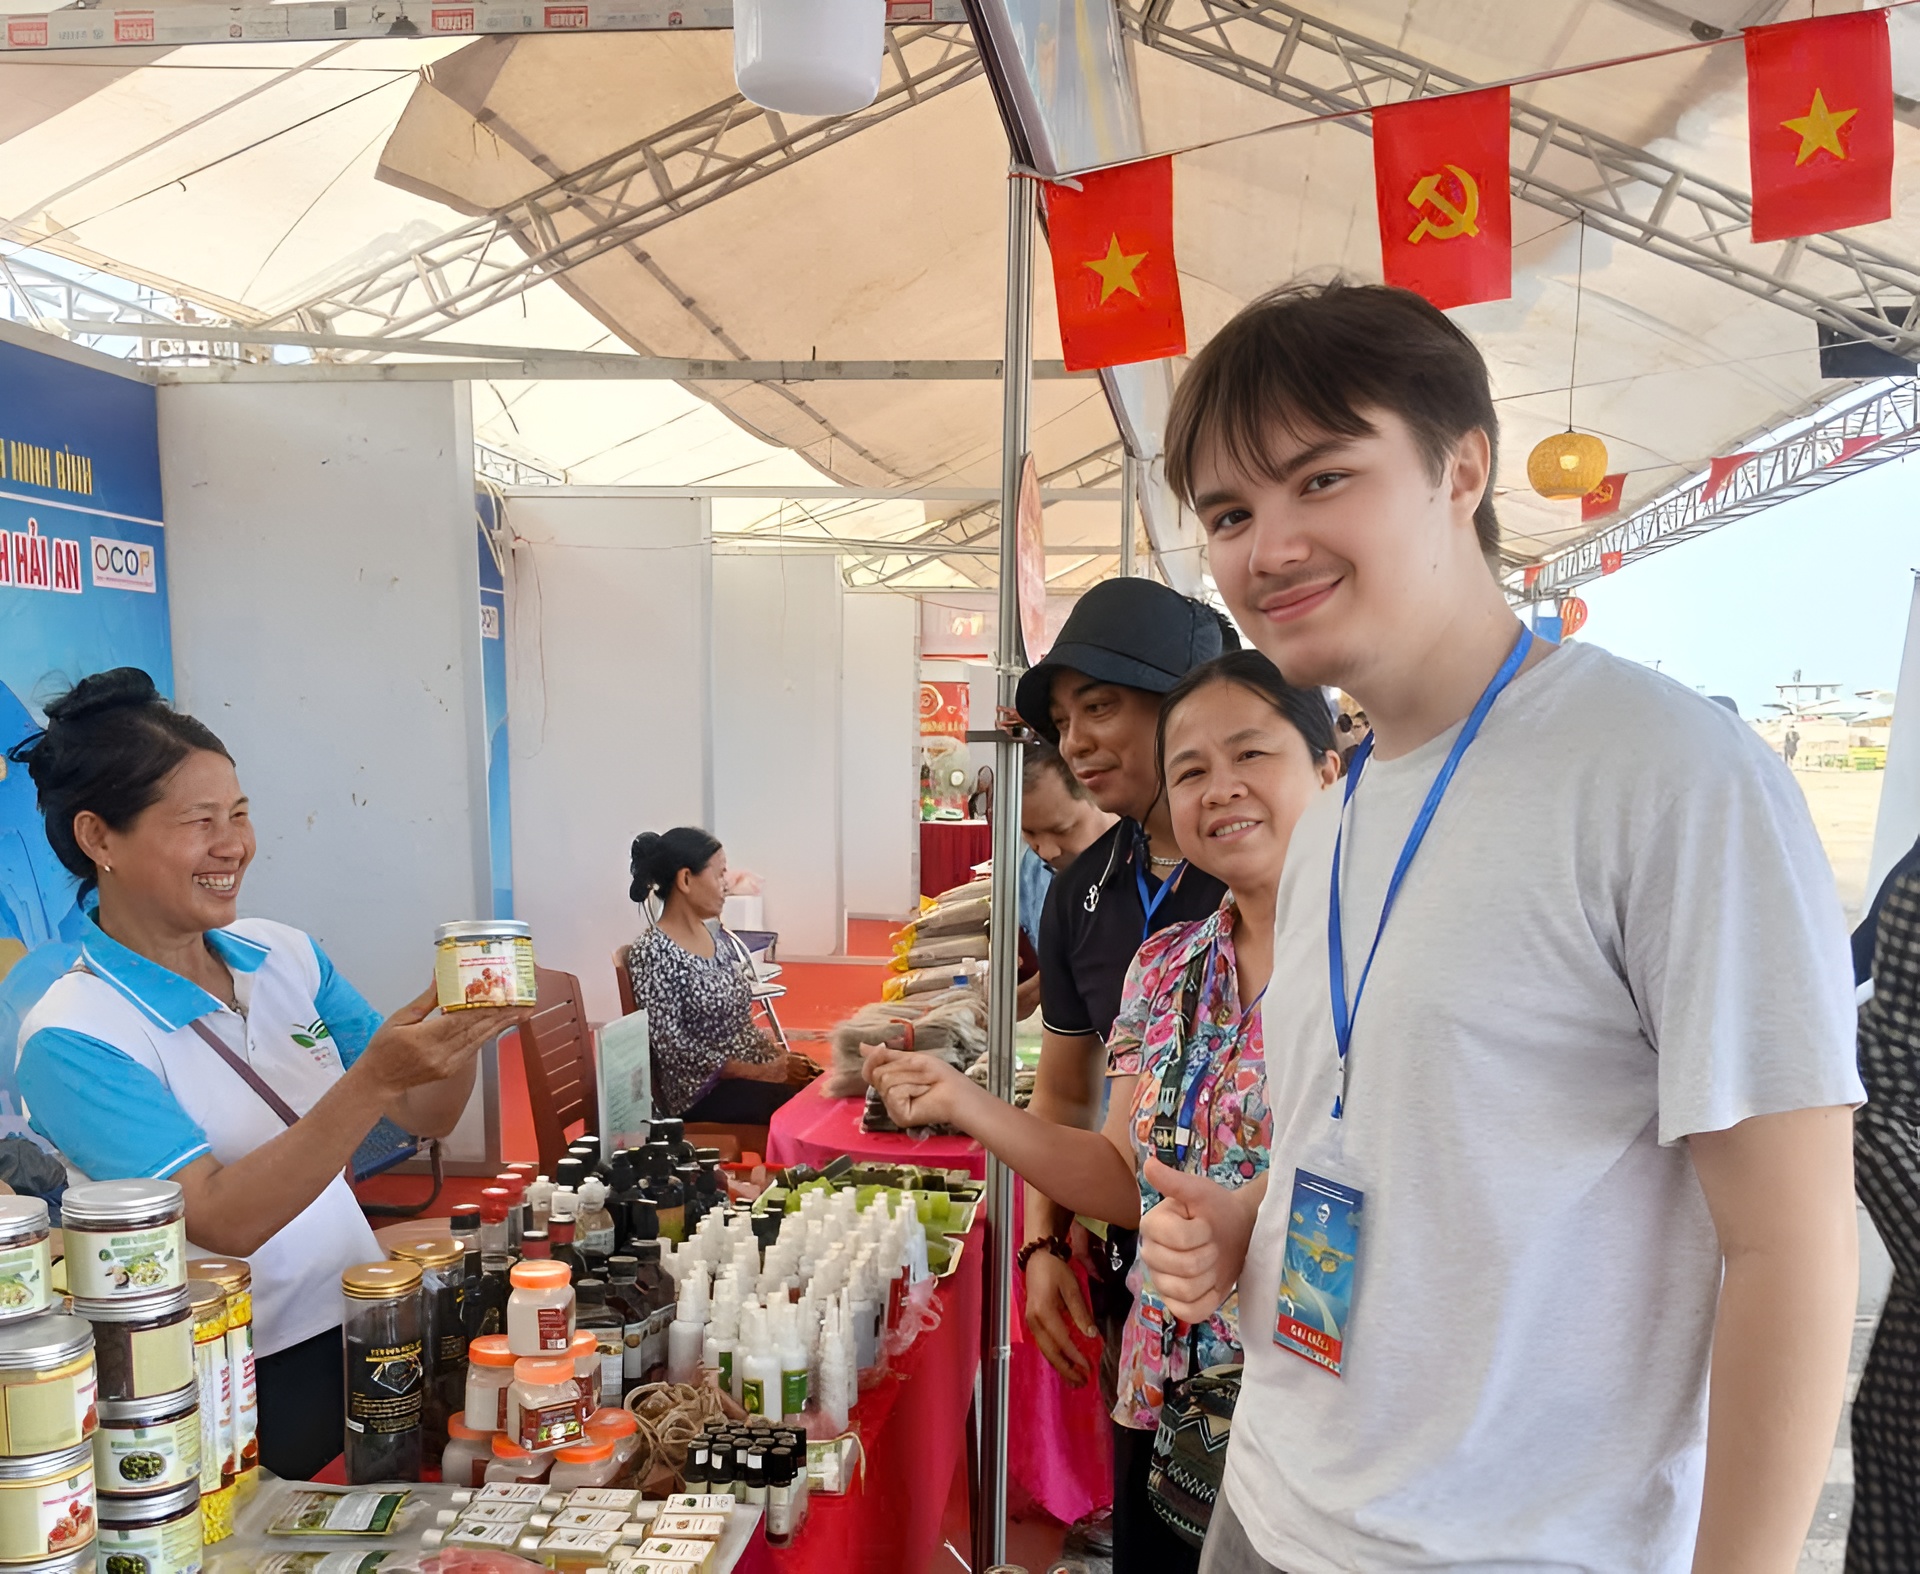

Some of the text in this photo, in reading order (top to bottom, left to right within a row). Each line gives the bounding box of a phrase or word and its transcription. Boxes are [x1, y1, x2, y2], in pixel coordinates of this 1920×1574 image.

[10, 440, 52, 488] NINH
[14, 519, 49, 588] HẢI
[54, 540, 80, 591] AN
[95, 543, 150, 576] OCOP
